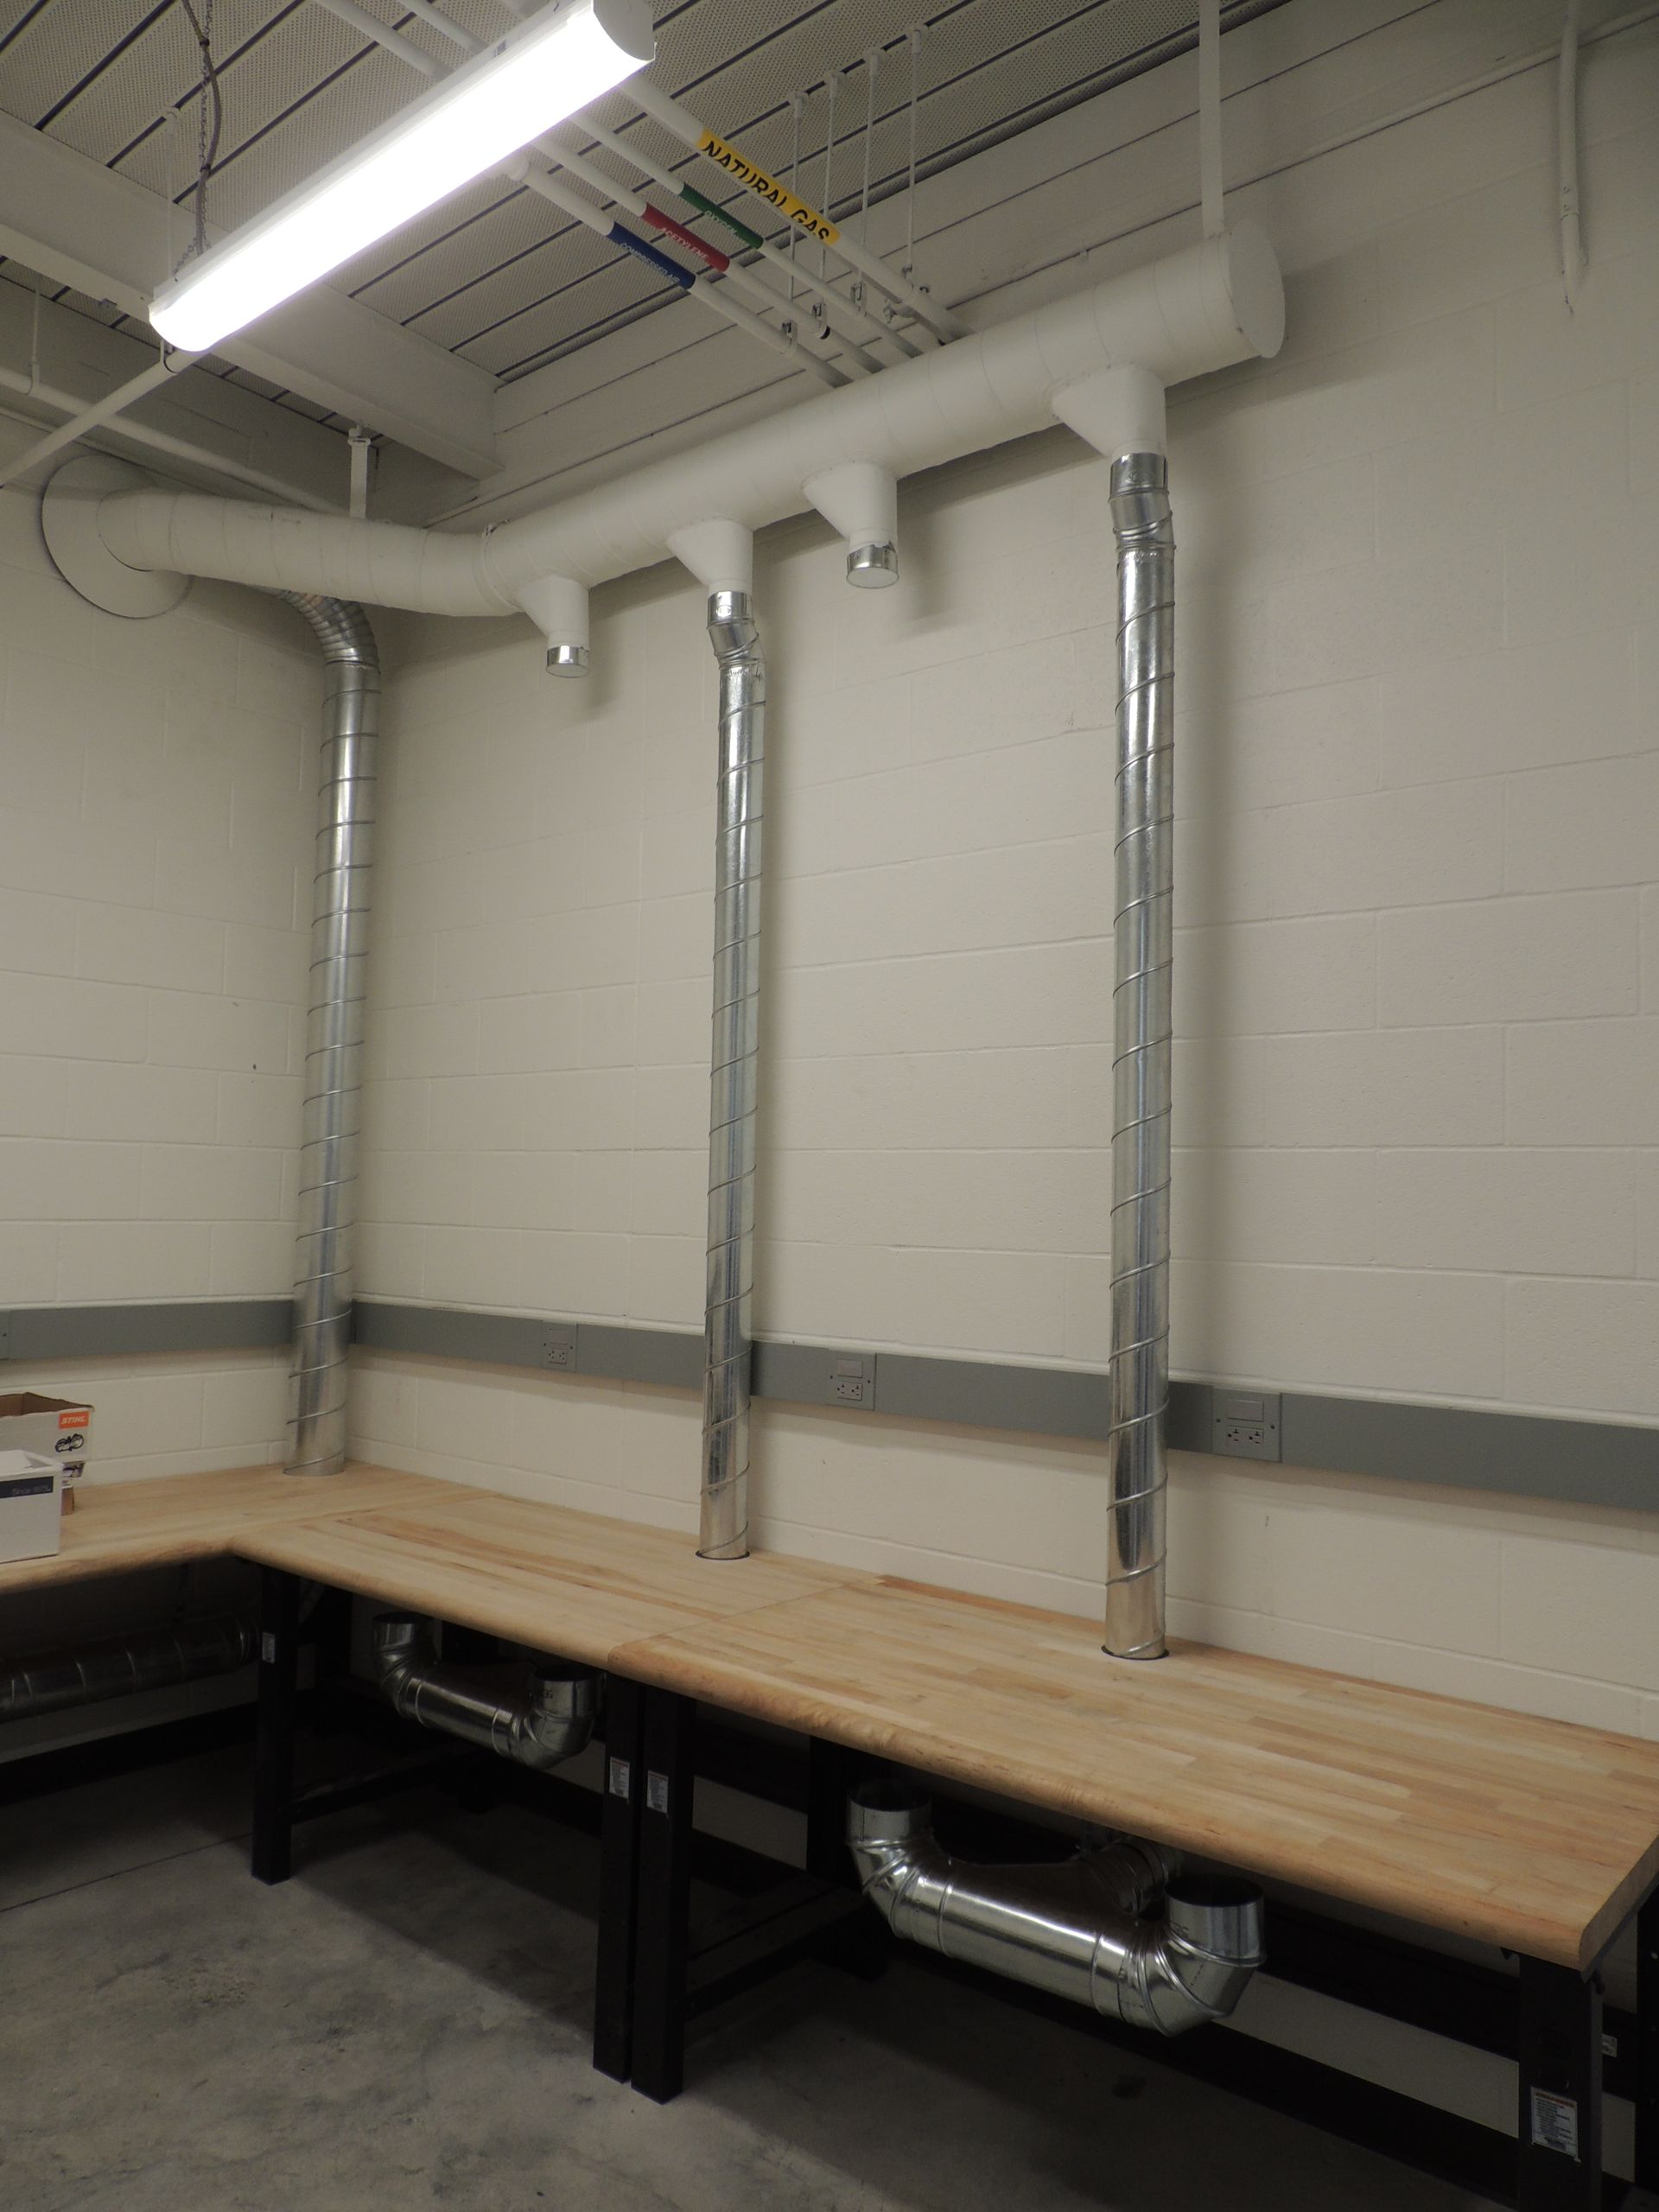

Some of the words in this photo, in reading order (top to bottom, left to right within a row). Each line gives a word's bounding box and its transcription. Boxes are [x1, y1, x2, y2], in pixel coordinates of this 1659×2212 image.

[702, 140, 787, 207] NATURAL
[790, 209, 830, 240] GAS
[620, 242, 668, 276] COMPRESSED
[659, 227, 710, 261] ACETYLENE
